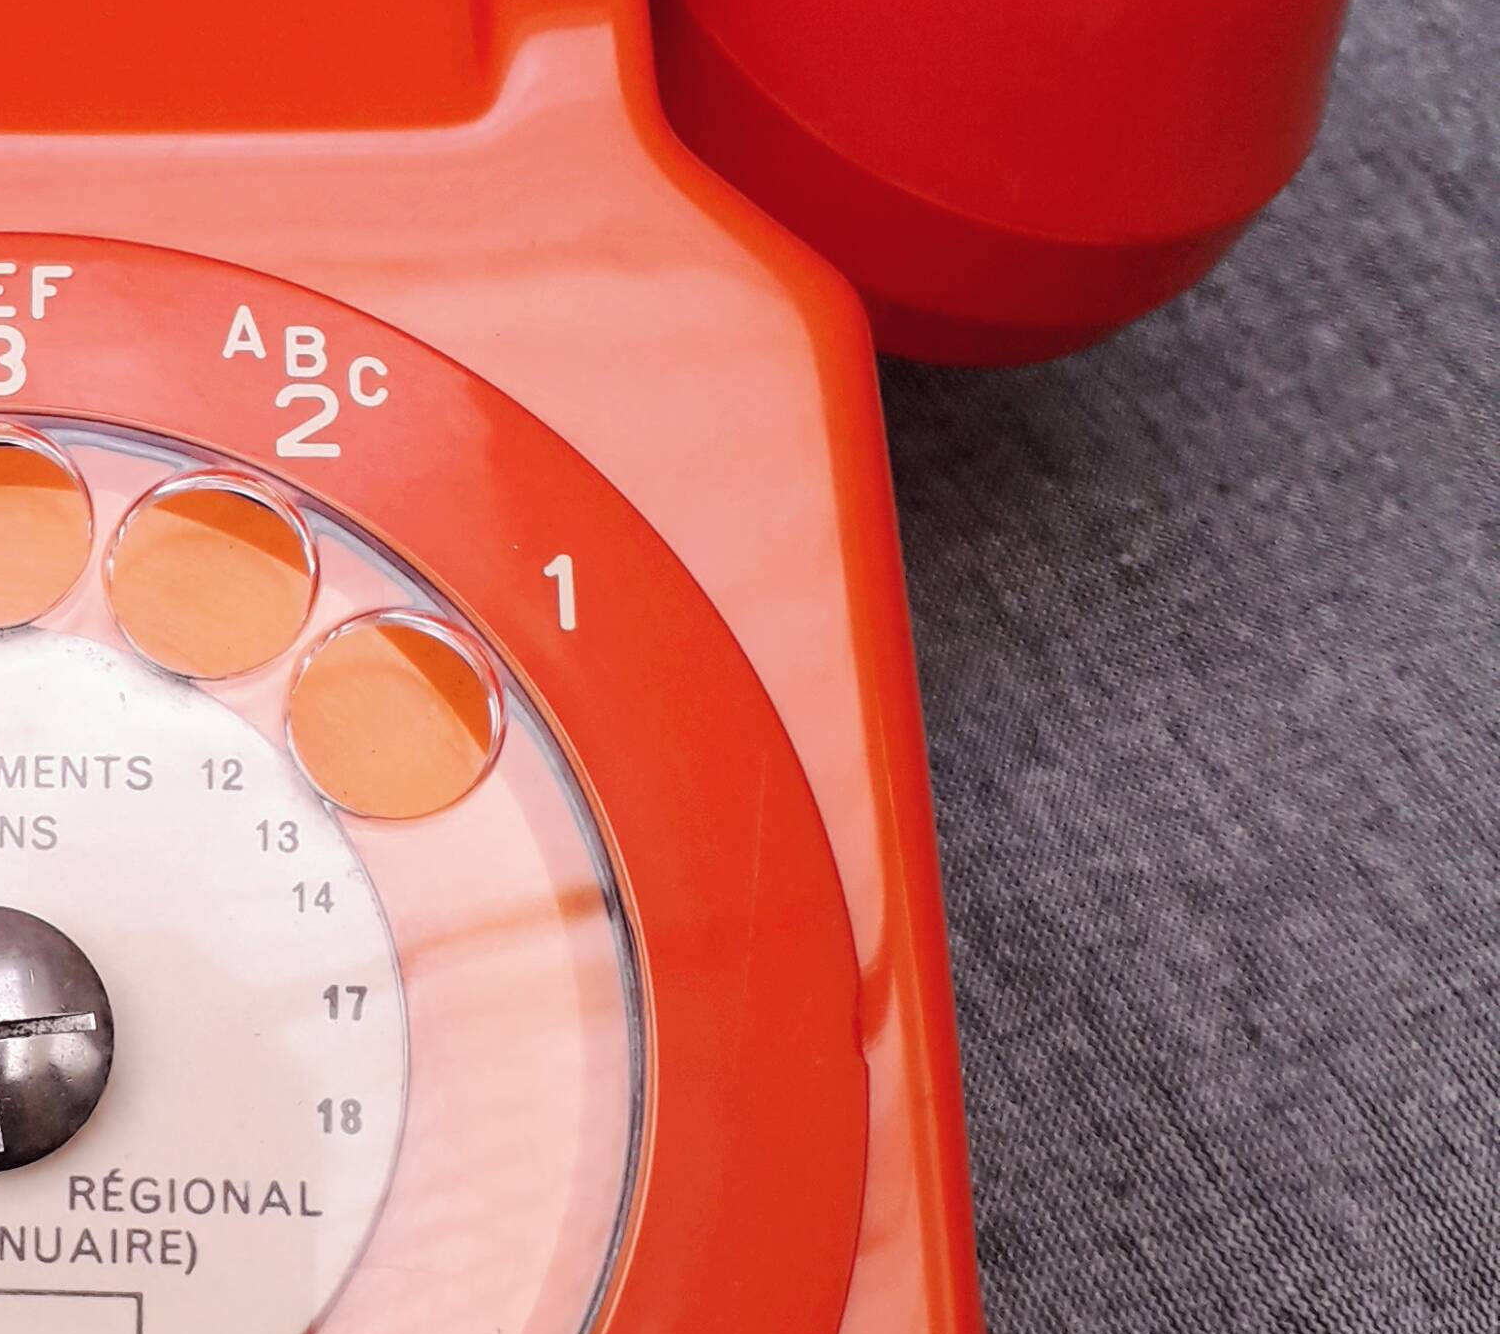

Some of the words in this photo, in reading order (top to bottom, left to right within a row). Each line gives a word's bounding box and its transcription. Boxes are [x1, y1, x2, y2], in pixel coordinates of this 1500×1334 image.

[275, 383, 341, 458] 2
[543, 553, 576, 631] 1
[201, 759, 244, 792] 12
[255, 821, 299, 853] 13
[292, 881, 335, 914] 14
[323, 985, 367, 1021] 17
[316, 1099, 363, 1136] 18
[68, 1168, 323, 1218] RÉGIONAL
